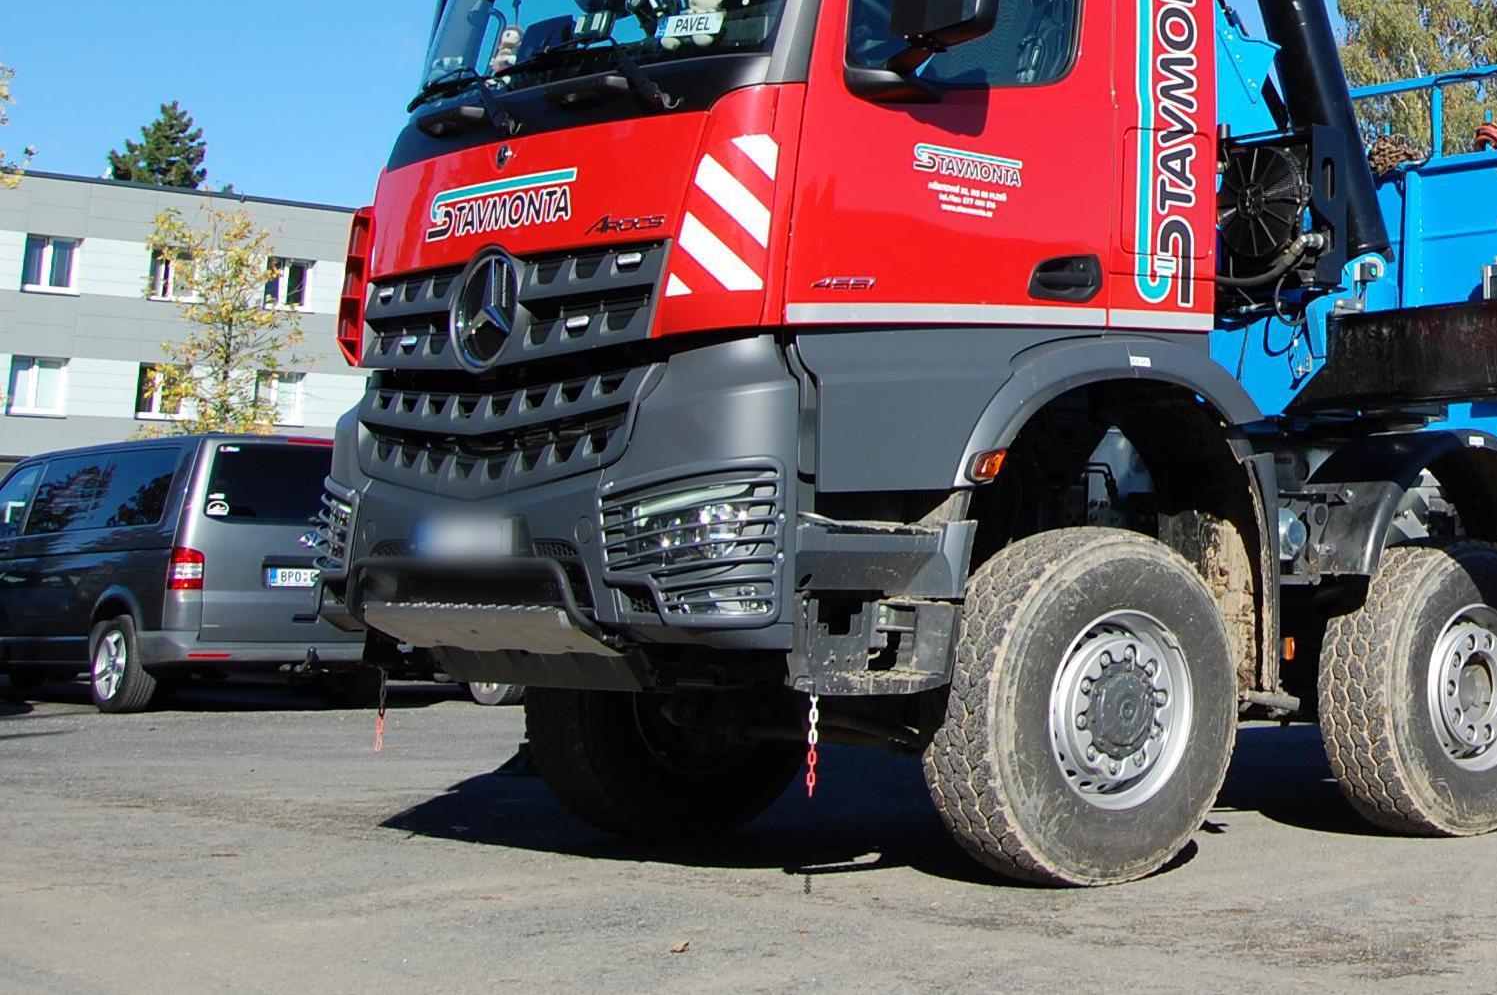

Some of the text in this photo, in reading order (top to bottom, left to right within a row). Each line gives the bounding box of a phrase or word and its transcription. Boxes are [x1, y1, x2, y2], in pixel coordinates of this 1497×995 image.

[674, 16, 710, 33] PAVEL
[913, 143, 1022, 187] STAVMONTA
[426, 168, 578, 243] STAVMONTA
